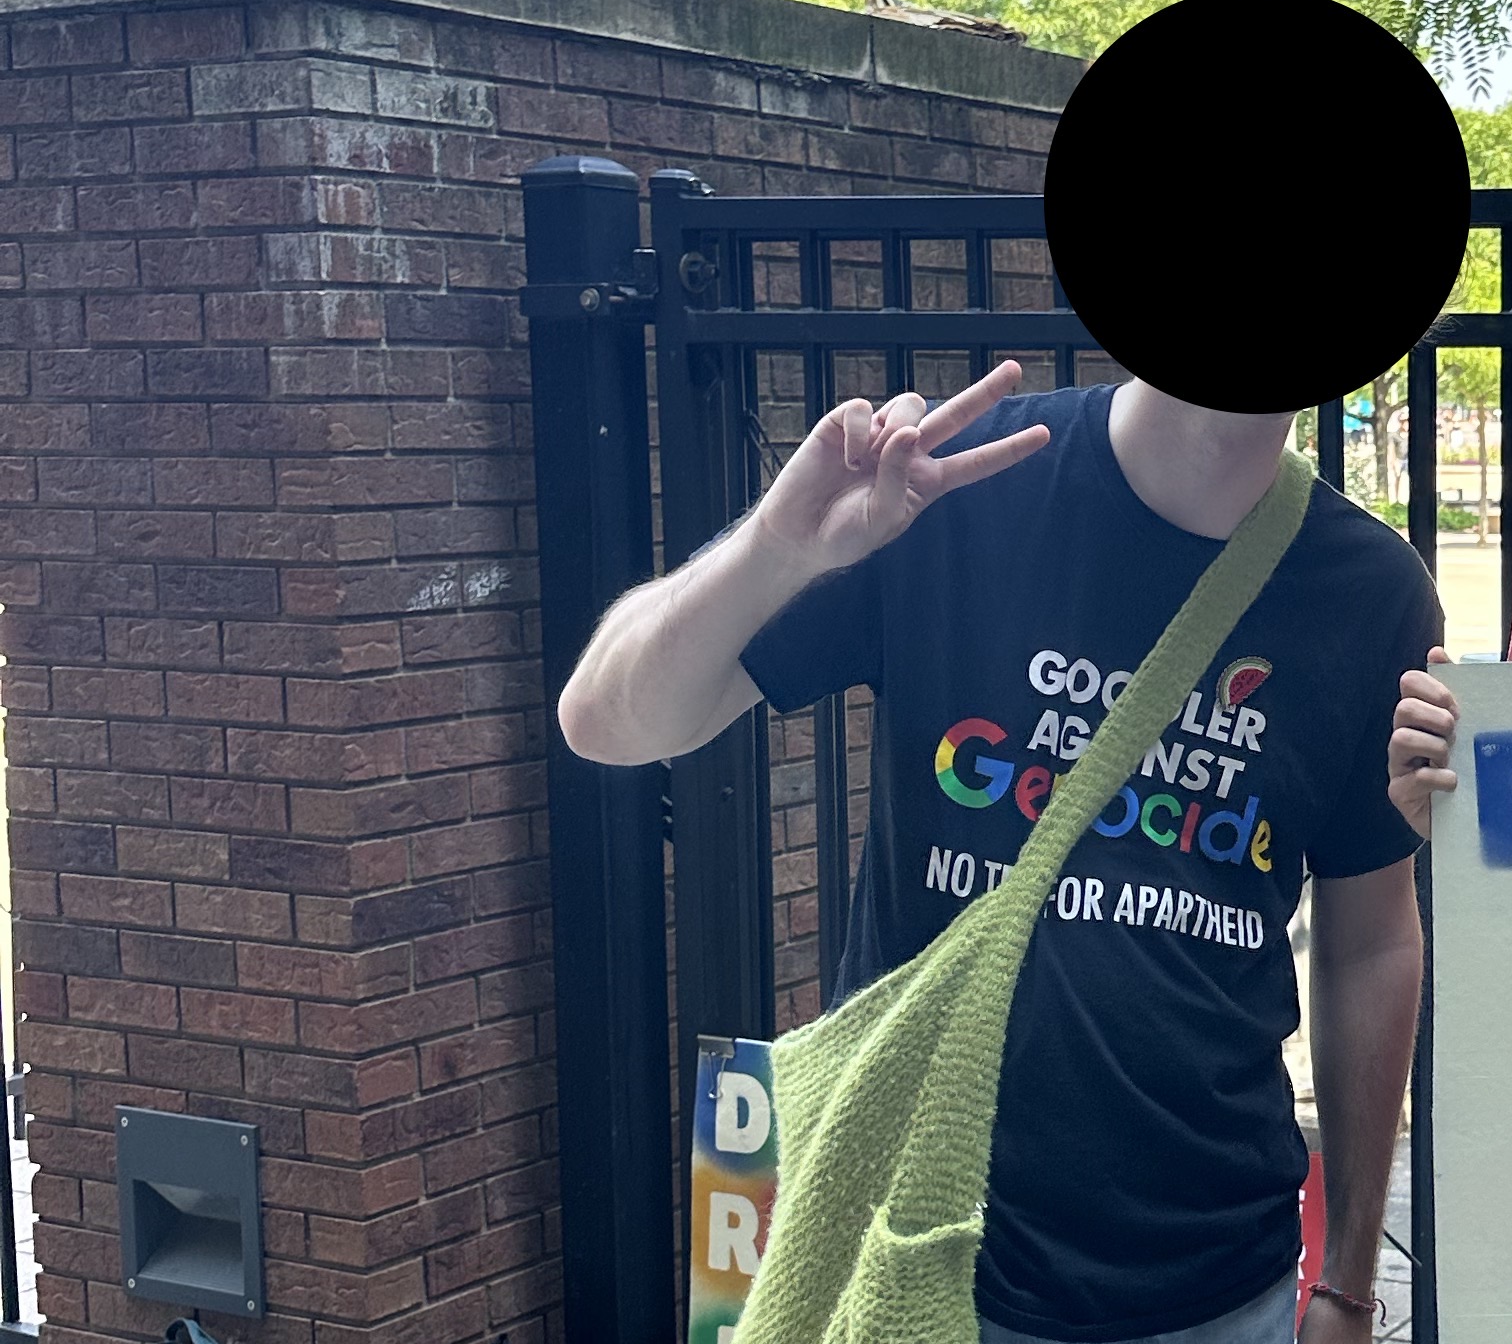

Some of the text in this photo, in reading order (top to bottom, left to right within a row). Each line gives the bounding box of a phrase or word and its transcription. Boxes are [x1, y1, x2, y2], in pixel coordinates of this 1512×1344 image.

[1029, 649, 1263, 753] GOOLER
[935, 718, 1273, 873] Geocide
[1027, 709, 1246, 799] AGNST
[926, 845, 976, 898] NO
[1113, 882, 1265, 950] APARTHEID
